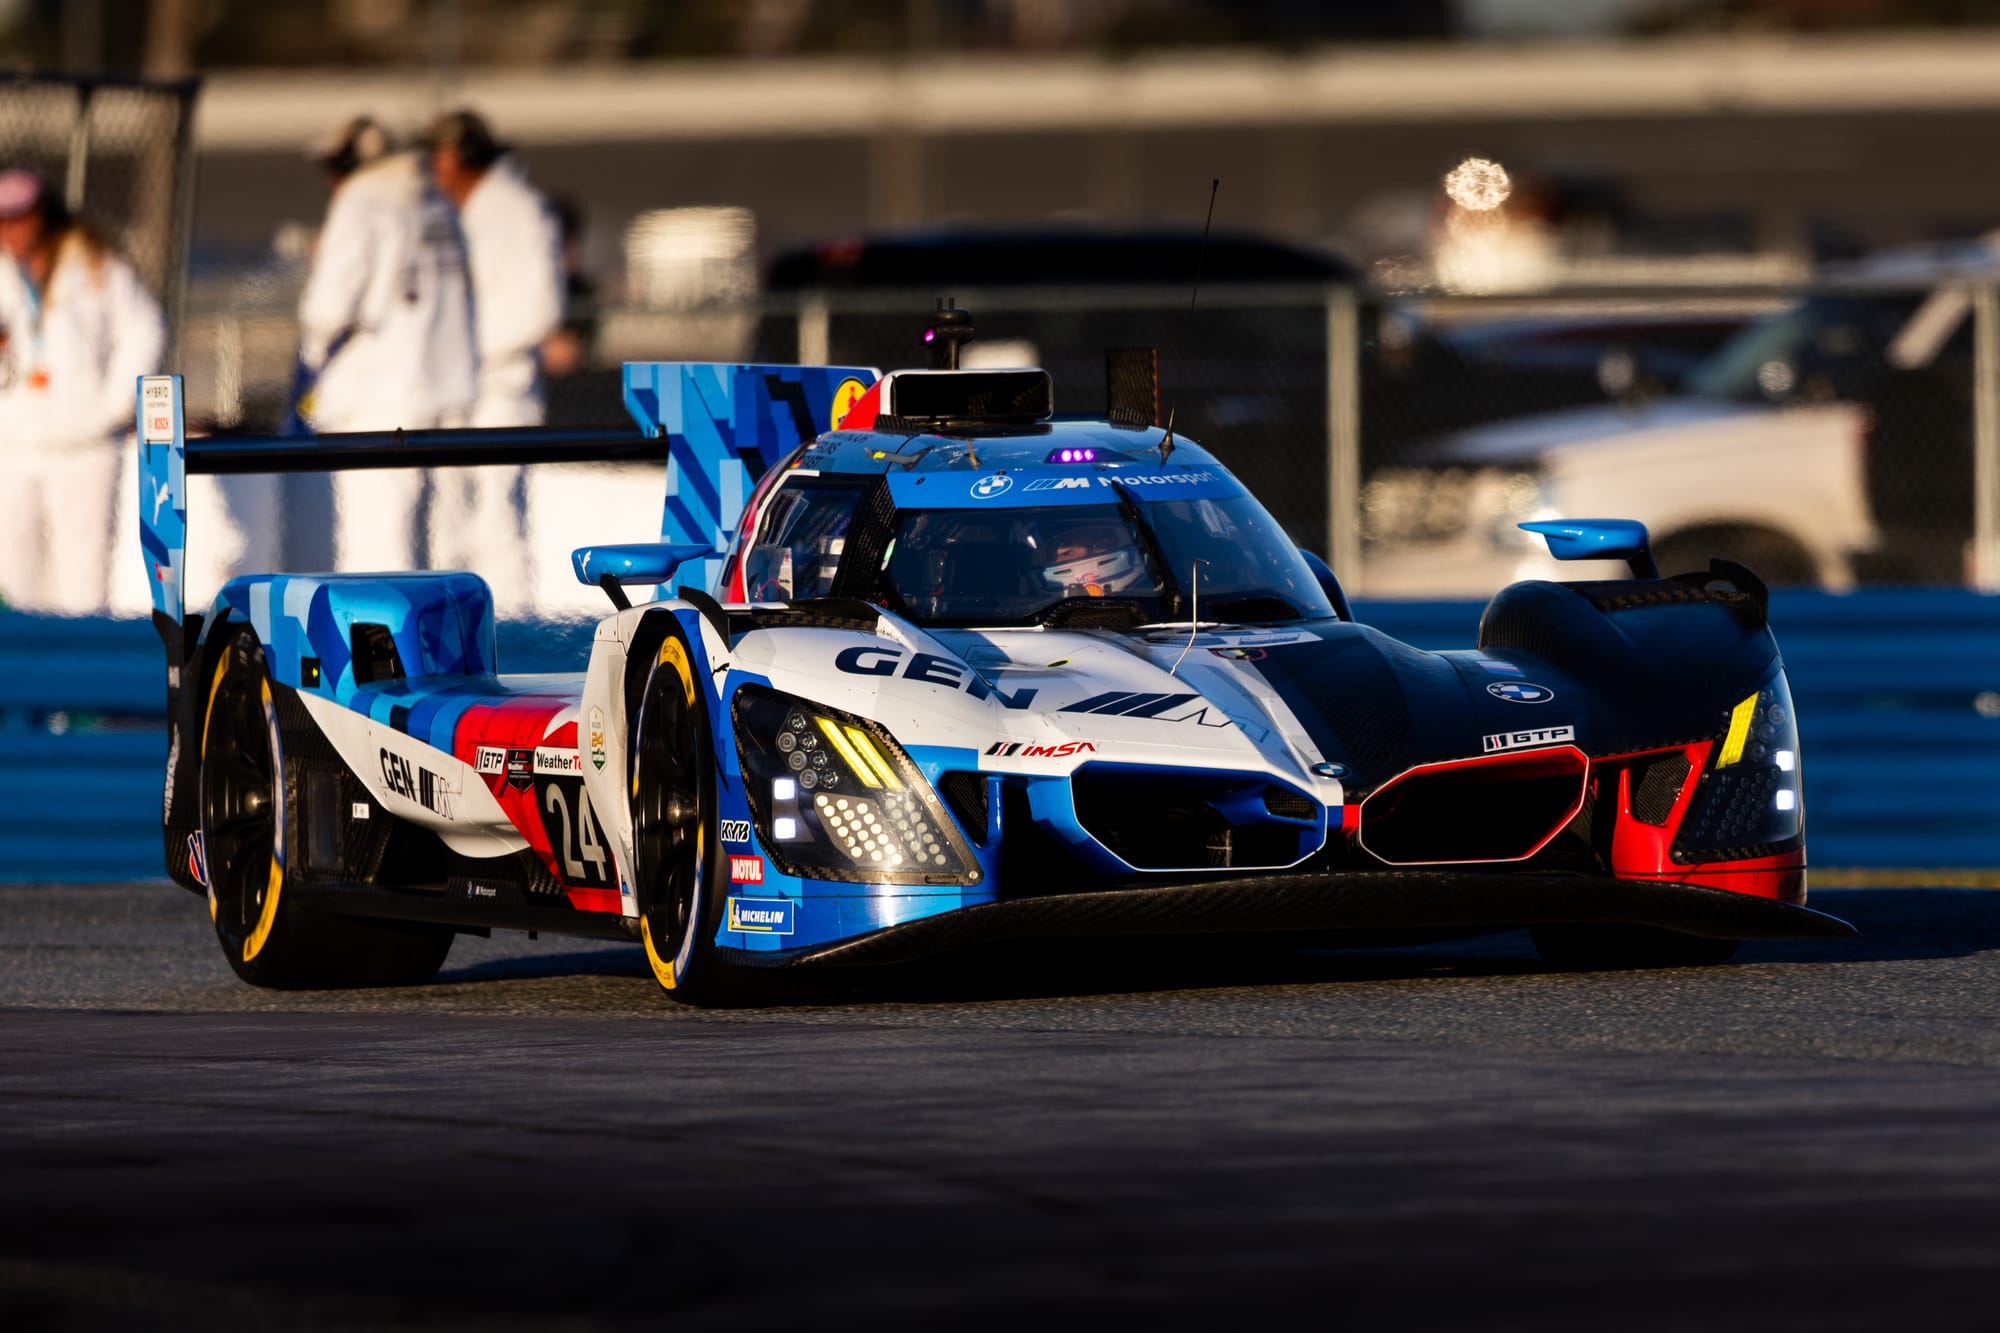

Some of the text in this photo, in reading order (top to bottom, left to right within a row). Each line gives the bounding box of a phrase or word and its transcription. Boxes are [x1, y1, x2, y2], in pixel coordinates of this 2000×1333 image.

[144, 385, 169, 399] HYBRID
[835, 646, 1039, 710] GEN
[1512, 728, 1569, 744] GTP
[483, 751, 503, 769] GTP
[380, 747, 417, 802] GEN
[546, 783, 606, 882] 24
[721, 820, 750, 842] KYB
[731, 858, 762, 881] MOTUL
[741, 909, 784, 924] MICHELIN
